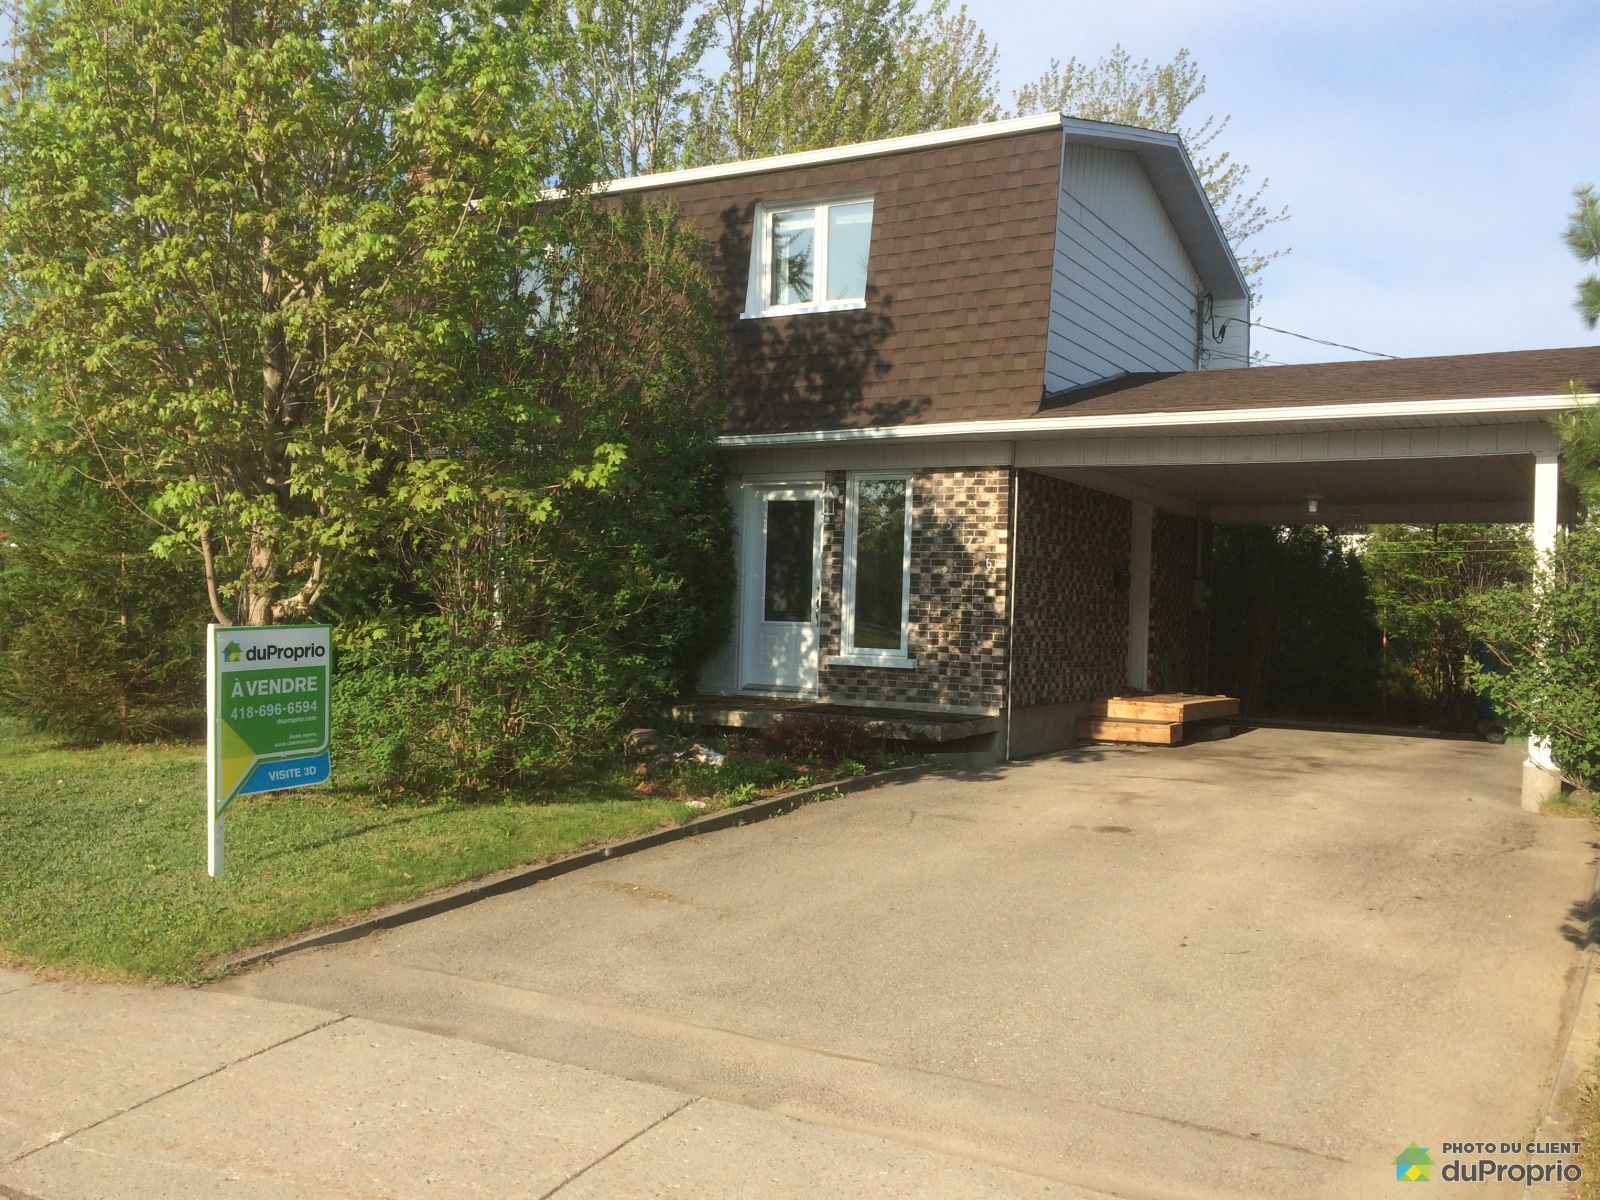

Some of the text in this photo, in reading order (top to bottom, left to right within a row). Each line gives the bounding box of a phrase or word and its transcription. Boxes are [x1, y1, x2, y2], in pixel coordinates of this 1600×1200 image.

[933, 502, 992, 569] 1576
[245, 643, 326, 661] duProprio
[231, 676, 318, 698] À VENDRE
[230, 700, 318, 720] 418-696-6594
[268, 766, 317, 781] VISITE 3D
